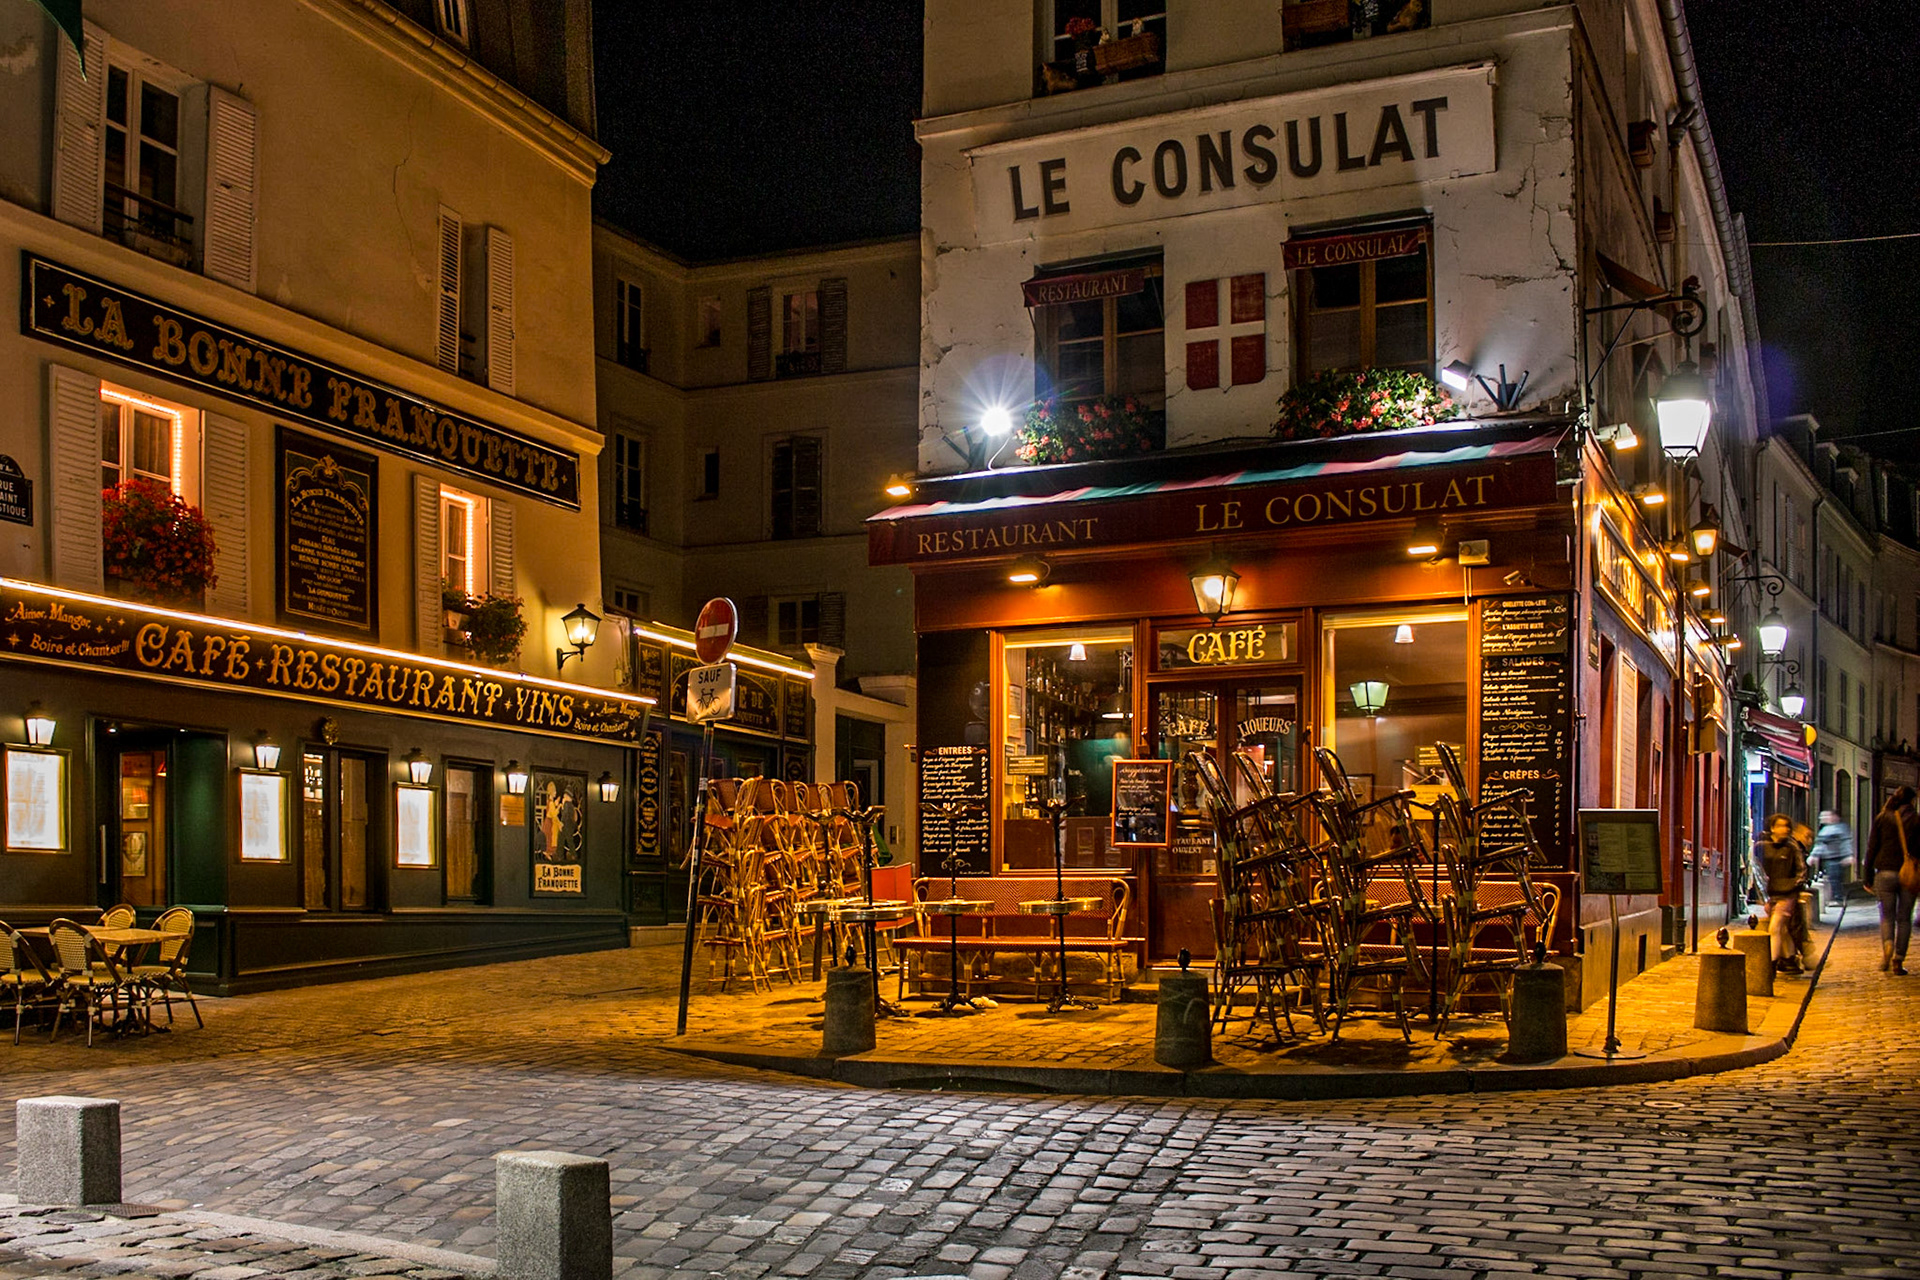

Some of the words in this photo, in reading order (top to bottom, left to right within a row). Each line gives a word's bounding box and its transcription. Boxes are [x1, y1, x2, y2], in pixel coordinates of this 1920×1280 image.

[1008, 158, 1071, 221] LE
[1111, 97, 1448, 206] CONSULAT
[1297, 246, 1317, 266] LE
[1324, 232, 1408, 262] CONSULAT
[1039, 273, 1132, 302] RESTAURANT
[61, 283, 134, 350] LA
[152, 315, 313, 409] BONNE
[327, 377, 559, 491] FRANQUETTE
[1195, 501, 1244, 532] LE
[1264, 475, 1495, 525] CONSULAT
[917, 518, 1098, 555] RESTAURANT
[5, 601, 47, 623] Aimer,
[49, 602, 92, 631] Manger,
[30, 633, 63, 654] Boire
[65, 643, 77, 655] et
[1187, 625, 1266, 663] CAFÉ
[136, 622, 251, 680] CAFÉ
[266, 644, 503, 717] RESTAURANT
[515, 687, 575, 727] VINS
[1502, 656, 1545, 667] SALADES
[698, 669, 722, 684] SAUF
[1237, 716, 1292, 737] LIQUEURS
[1502, 769, 1540, 780] CRÊPES
[538, 877, 578, 890] FRANQUETTE
[542, 866, 551, 878] LA
[553, 866, 574, 878] BONNE
